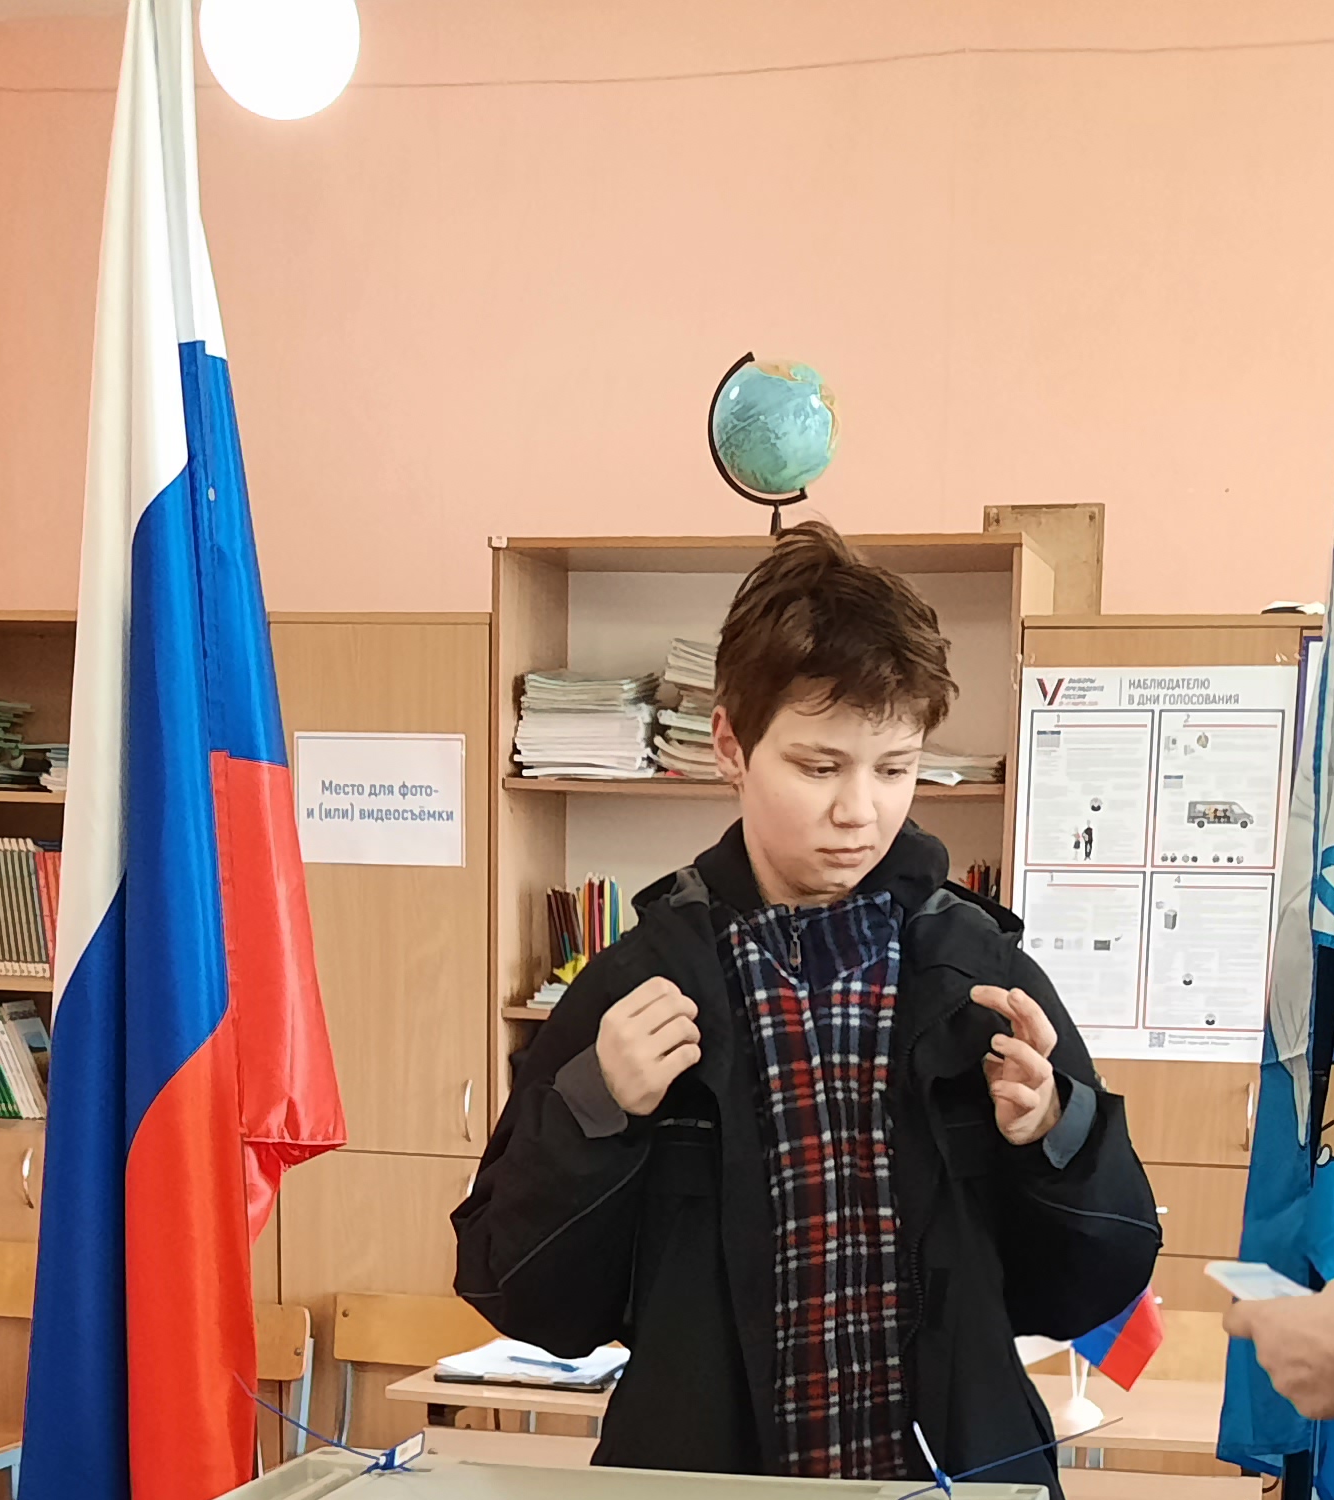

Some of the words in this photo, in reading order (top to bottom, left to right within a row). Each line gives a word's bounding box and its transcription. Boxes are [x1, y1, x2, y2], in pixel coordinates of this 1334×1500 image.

[1128, 678, 1210, 690] НАБЛЮДАТЕЛЮ
[1128, 694, 1135, 705] В
[1137, 694, 1160, 706] ДНИ
[1163, 694, 1239, 706] ГОЛОСОВАНИЯ
[321, 780, 365, 796] Место
[367, 783, 394, 798] для
[399, 781, 439, 800] фото-
[307, 808, 314, 819] и
[319, 802, 354, 821] (или)
[359, 806, 453, 822] видеосъёмки
